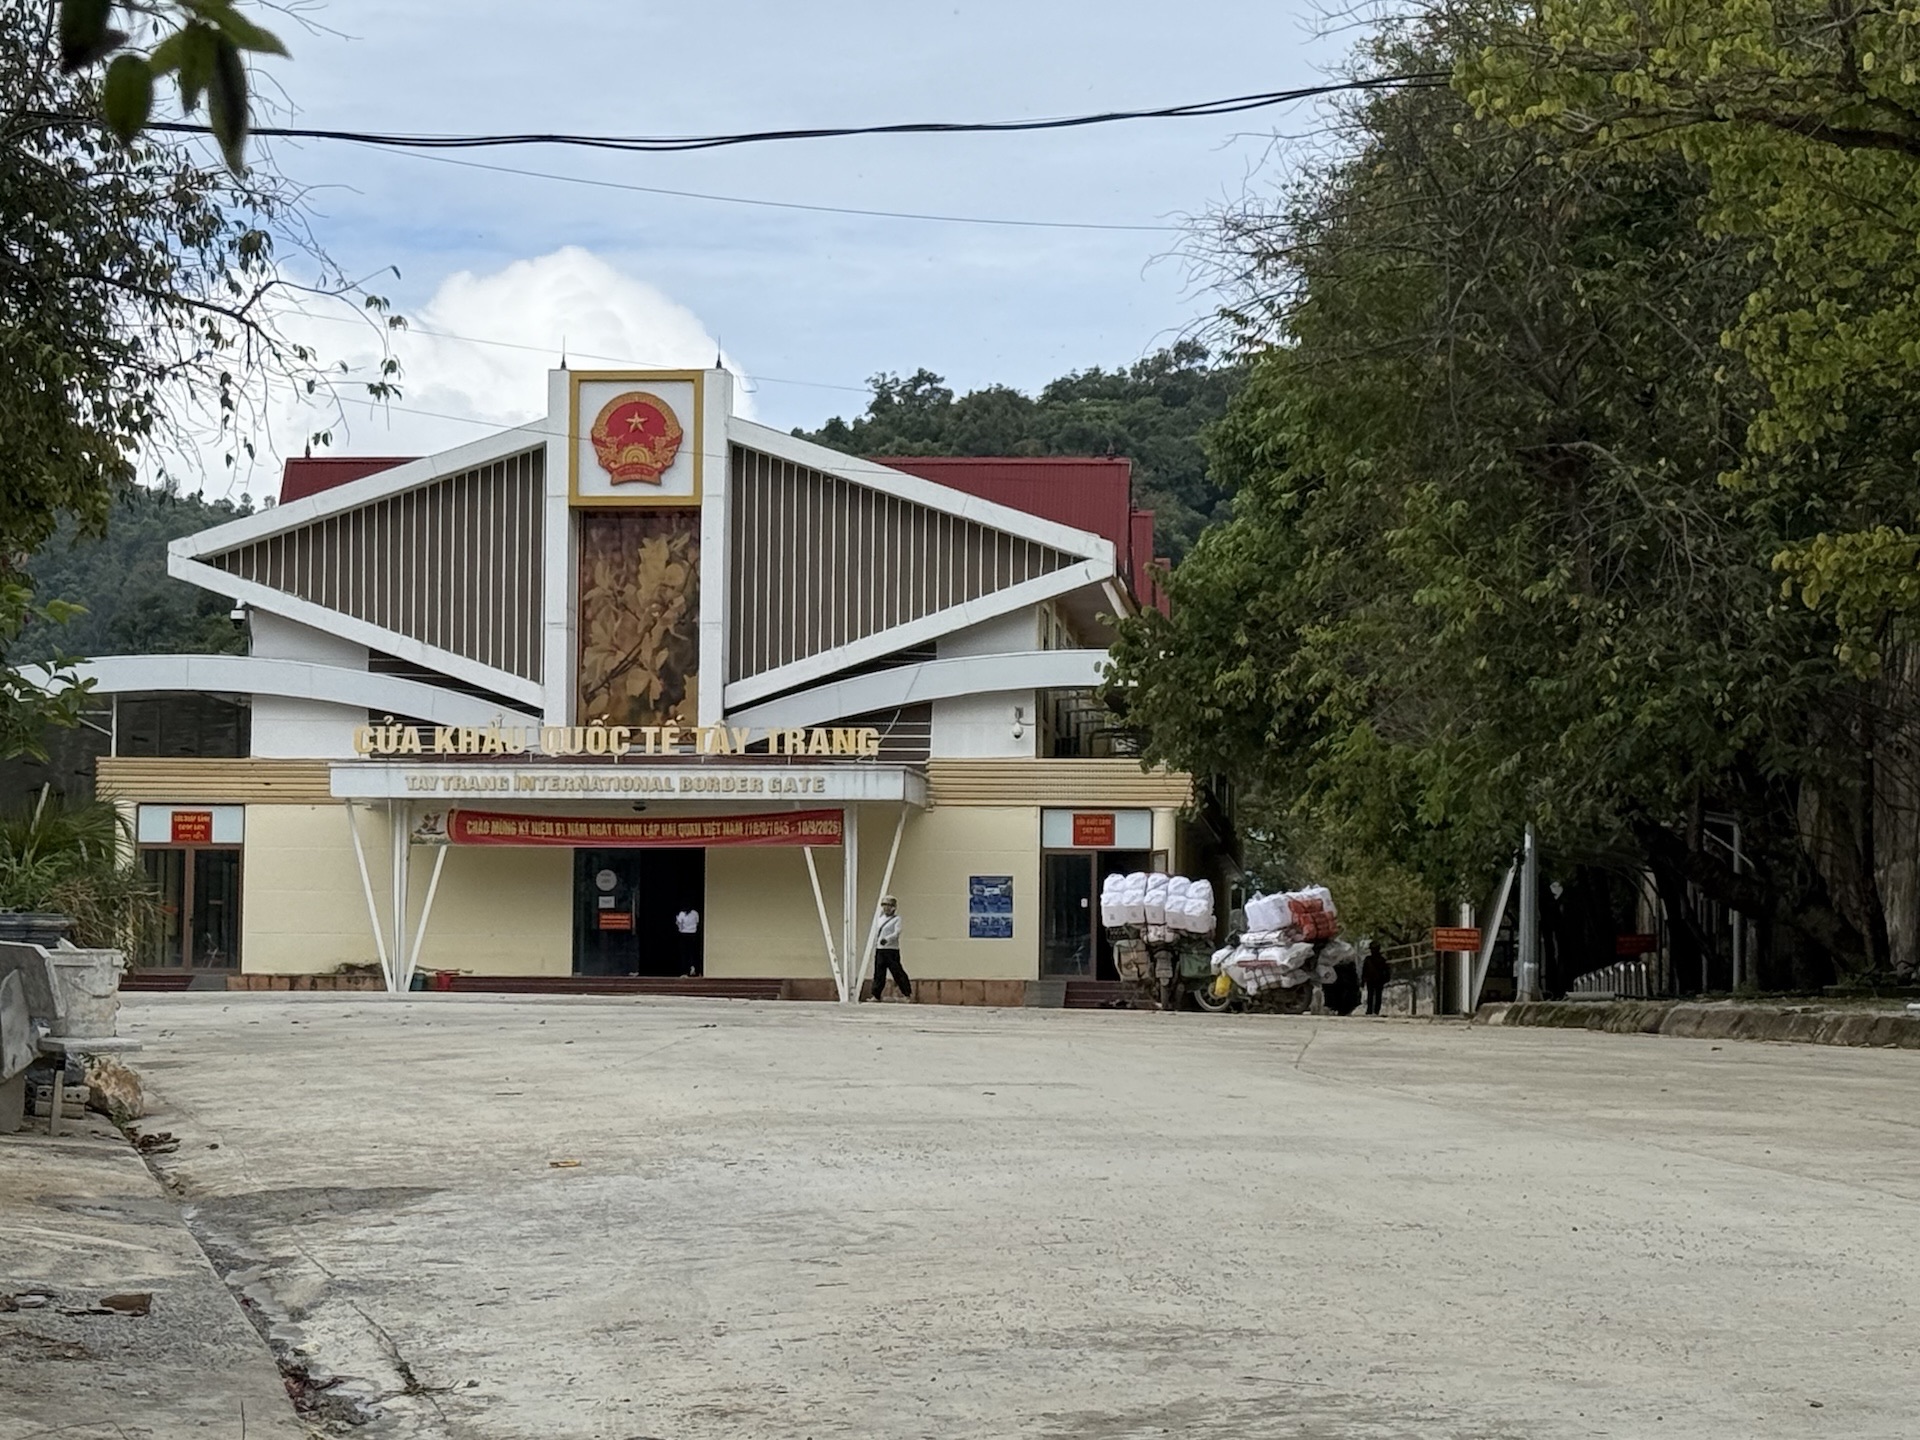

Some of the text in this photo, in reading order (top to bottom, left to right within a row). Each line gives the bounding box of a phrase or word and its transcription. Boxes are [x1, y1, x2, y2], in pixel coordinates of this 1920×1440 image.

[354, 715, 422, 755] CỬA
[540, 713, 631, 758] QUỐC
[641, 714, 684, 756] TẾ
[691, 719, 750, 756] TÂY
[768, 726, 880, 757] TRANG
[405, 775, 826, 793] TAY TRANG INTERNATIONAL BORDER GATE
